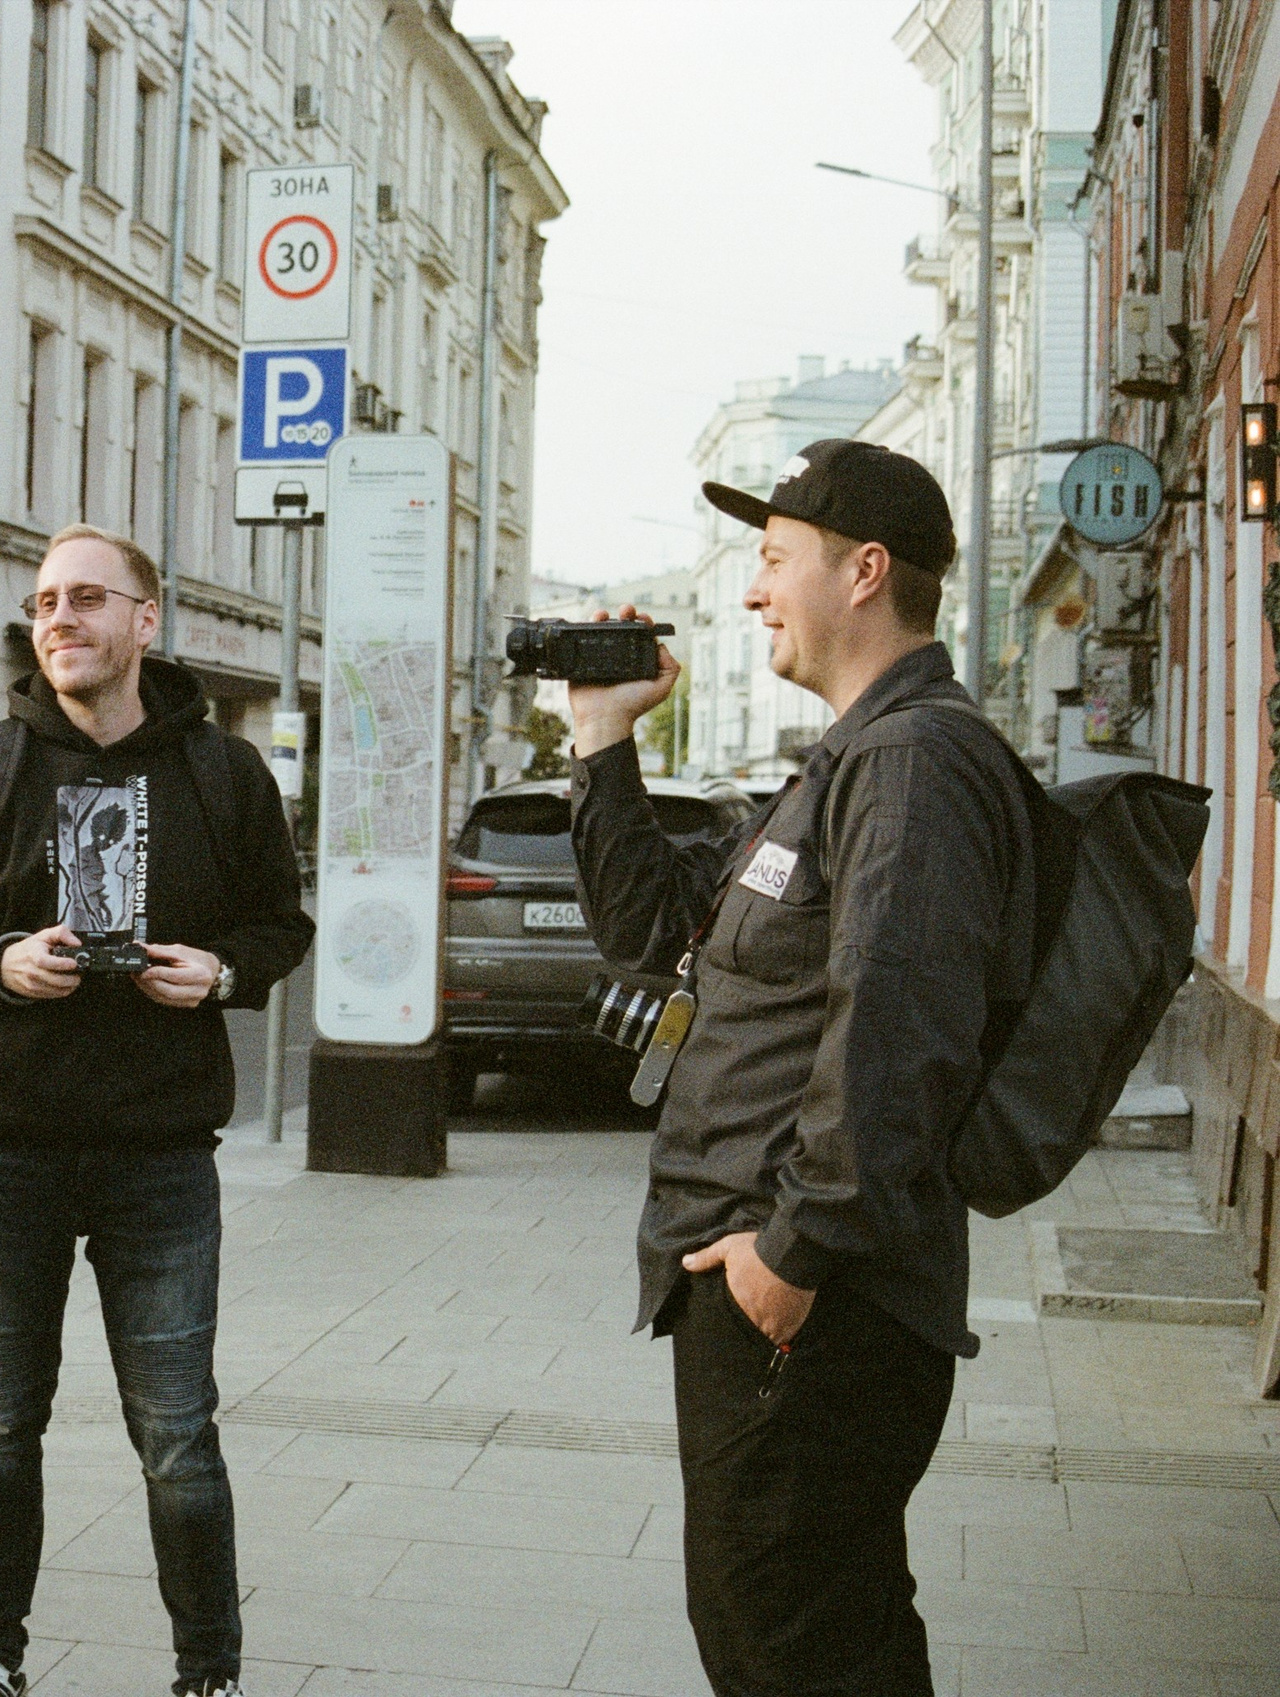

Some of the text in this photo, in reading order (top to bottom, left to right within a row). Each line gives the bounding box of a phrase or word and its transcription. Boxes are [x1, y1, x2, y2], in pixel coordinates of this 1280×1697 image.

[270, 177, 330, 198] ЗОНА
[277, 240, 320, 274] 30
[263, 356, 325, 449] P
[311, 426, 330, 441] 20
[1074, 483, 1150, 518] FISH
[134, 775, 149, 914] WHITE T-POISON
